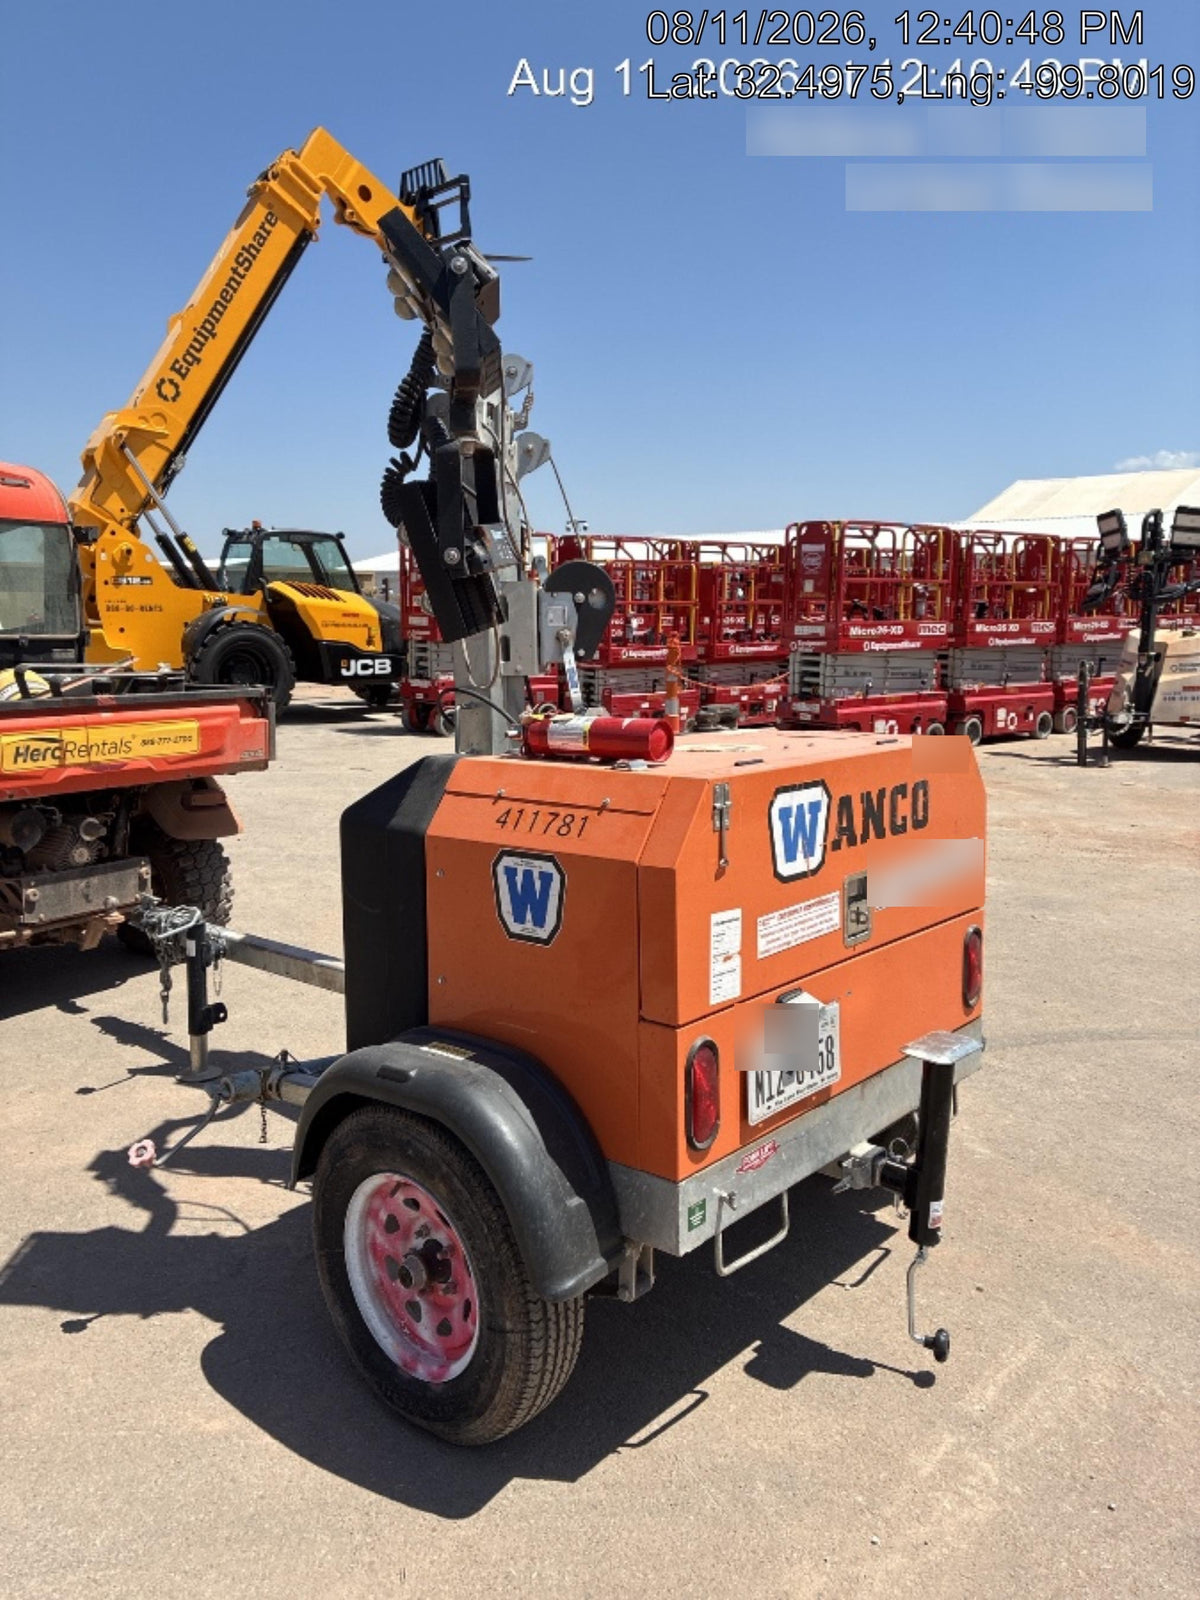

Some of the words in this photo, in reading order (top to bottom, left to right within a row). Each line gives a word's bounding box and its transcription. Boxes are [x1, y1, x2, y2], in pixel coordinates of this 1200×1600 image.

[170, 208, 279, 382] EquipmentShare
[341, 658, 392, 677] JCB
[495, 808, 590, 839] 411781
[778, 780, 929, 864] WANCO
[503, 865, 554, 929] W
